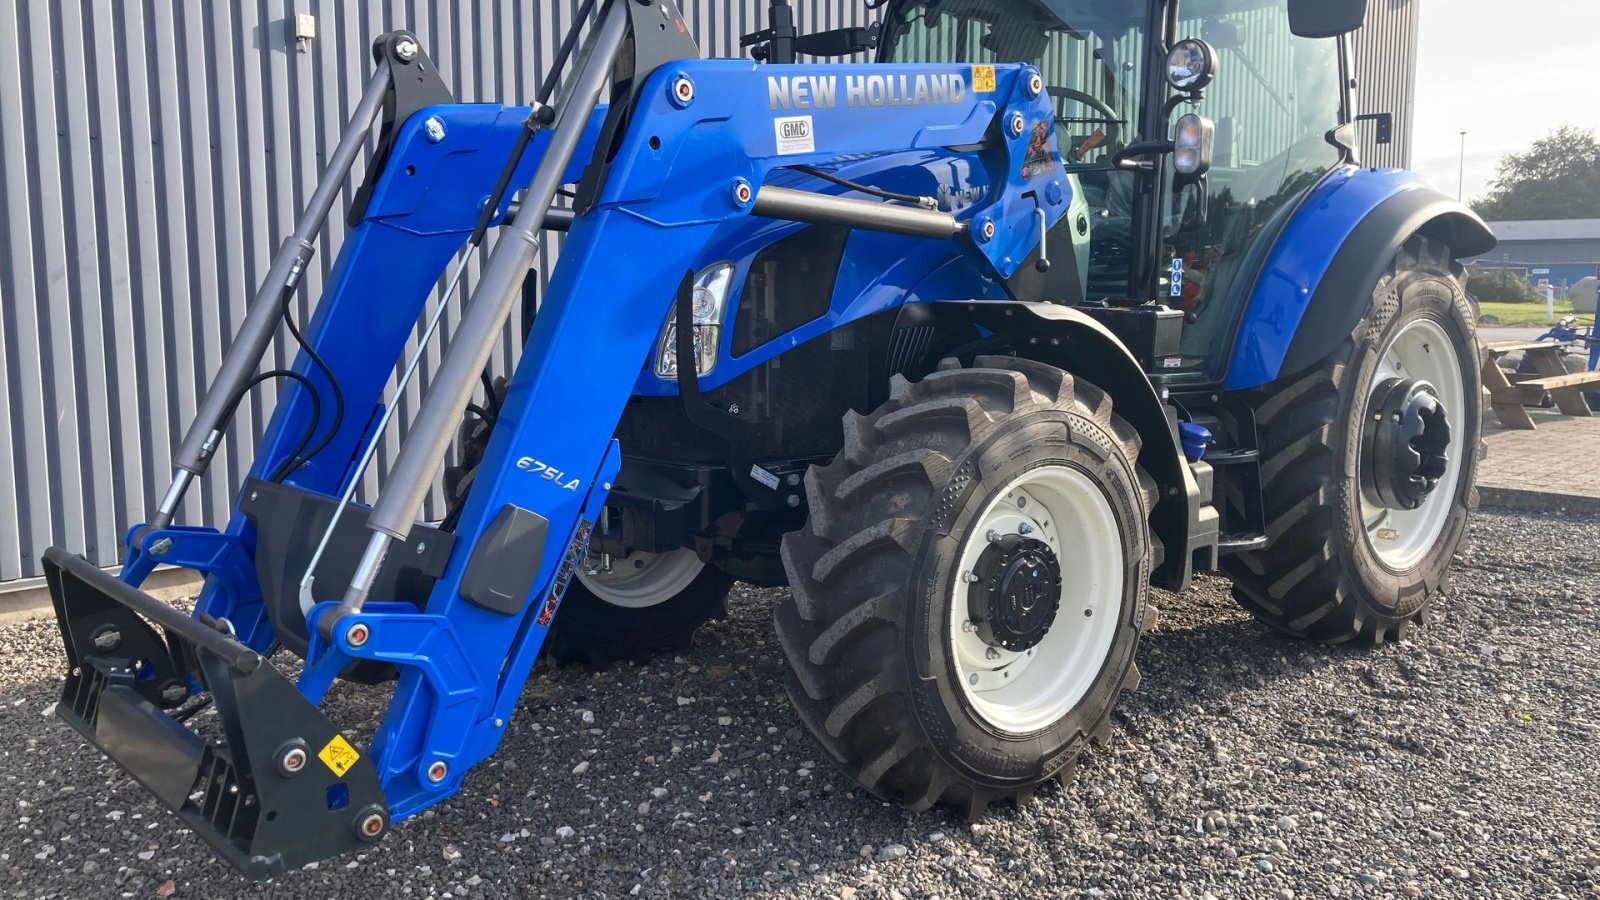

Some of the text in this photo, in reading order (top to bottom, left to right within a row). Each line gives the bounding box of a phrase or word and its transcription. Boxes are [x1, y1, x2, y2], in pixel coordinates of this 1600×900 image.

[767, 74, 966, 110] NEW HOLLAND
[783, 122, 806, 137] GMC
[516, 456, 580, 491] 675LA
